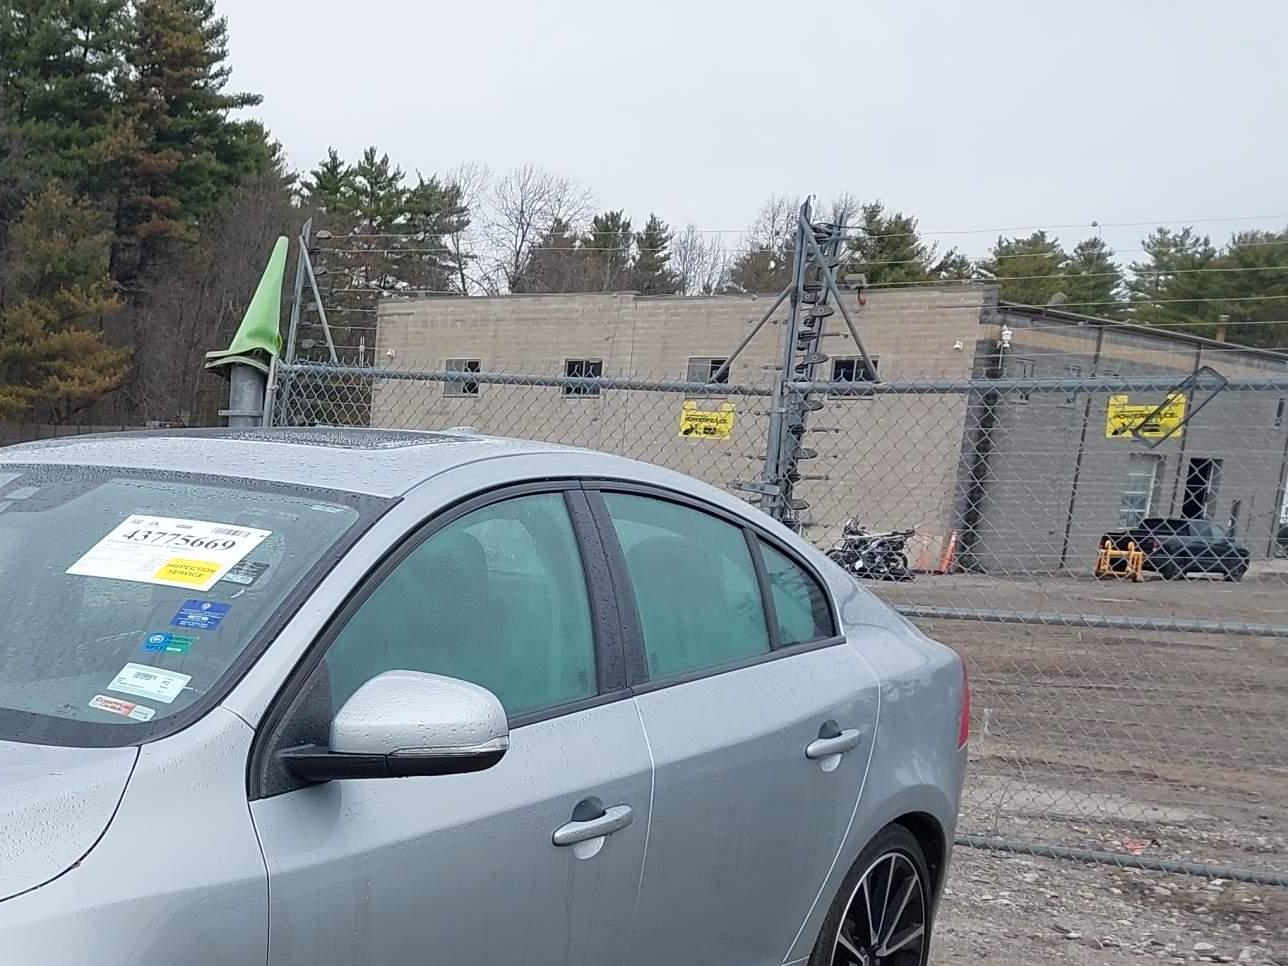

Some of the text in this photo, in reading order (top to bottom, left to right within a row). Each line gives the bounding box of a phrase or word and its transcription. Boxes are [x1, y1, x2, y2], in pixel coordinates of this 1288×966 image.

[123, 529, 236, 551] 43775669
[166, 563, 217, 574] INSPECTION
[167, 569, 205, 578] SERVICE
